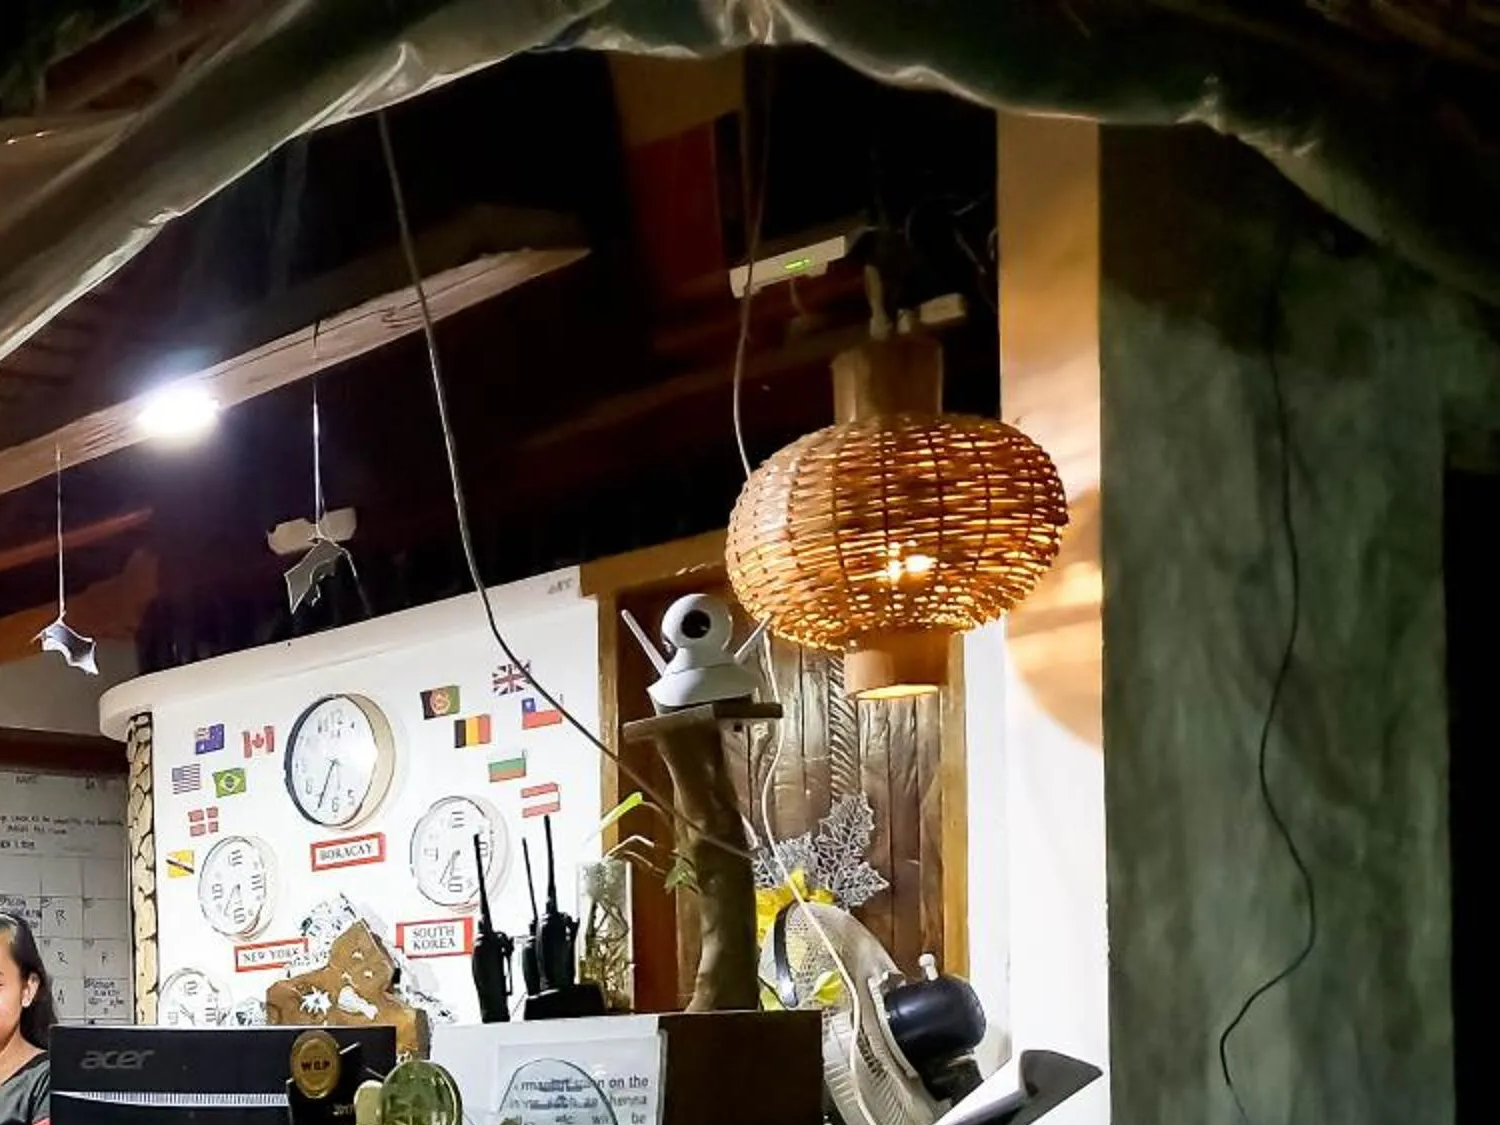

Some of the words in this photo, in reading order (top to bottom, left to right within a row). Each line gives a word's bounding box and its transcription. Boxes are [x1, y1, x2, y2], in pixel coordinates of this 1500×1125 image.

[319, 843, 374, 861] BORACAY
[413, 925, 455, 939] SOUTH
[412, 937, 457, 950] KOREA
[243, 950, 265, 963] NEW
[80, 1050, 156, 1070] acer
[609, 1077, 624, 1088] on
[628, 1074, 649, 1088] the
[631, 1112, 646, 1125] be
